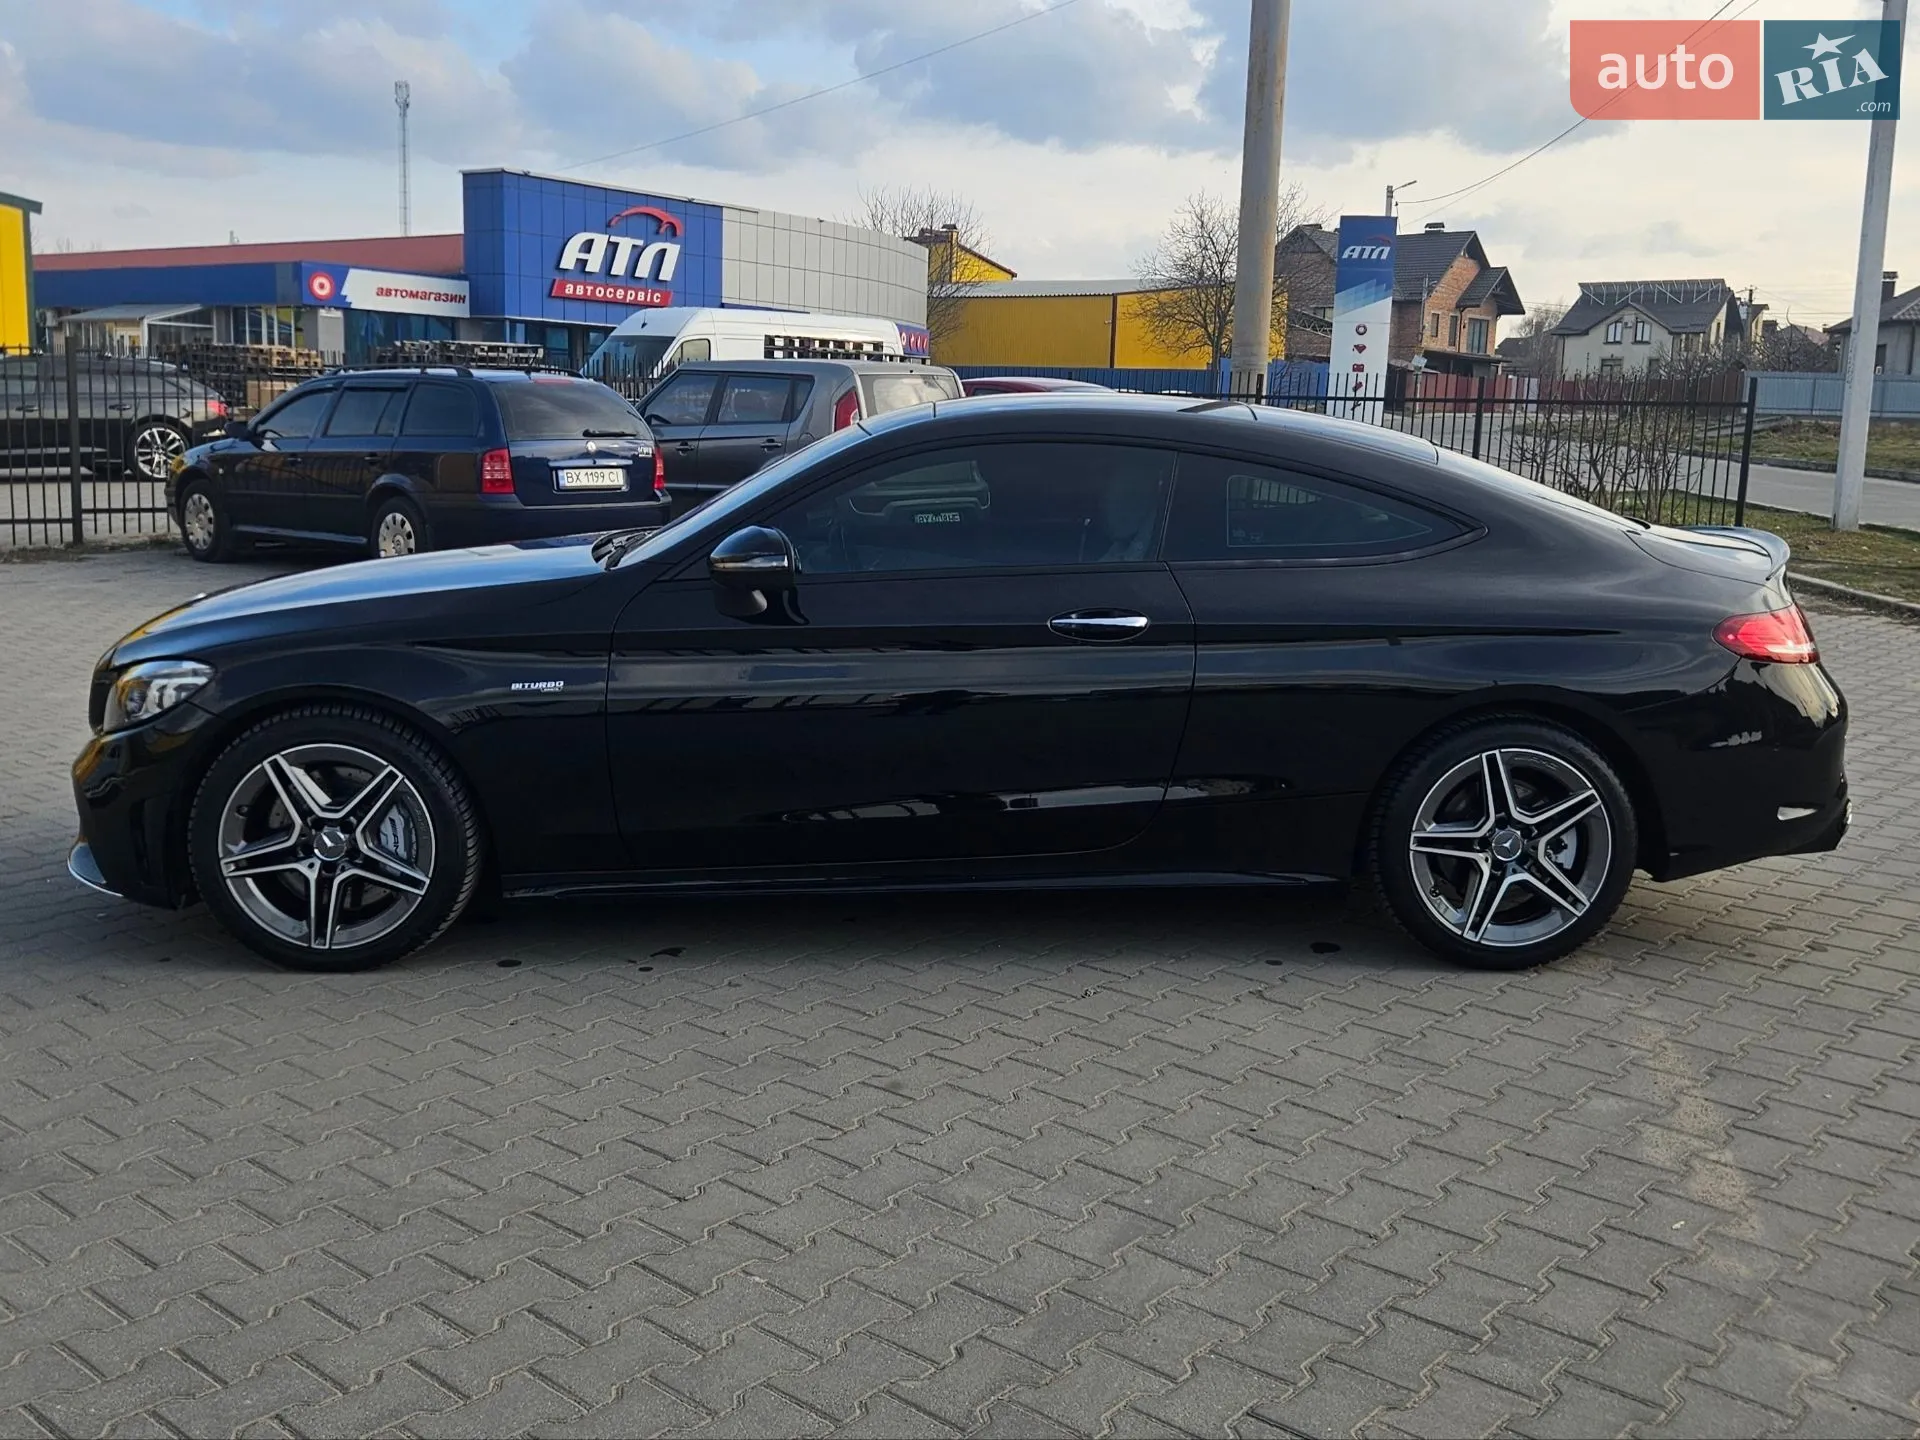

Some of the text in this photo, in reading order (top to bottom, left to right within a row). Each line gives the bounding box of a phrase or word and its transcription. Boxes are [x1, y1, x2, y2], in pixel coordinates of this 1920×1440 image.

[559, 231, 681, 282] АТЛ
[375, 286, 467, 305] автомагазин
[565, 283, 662, 303] автосервіс
[565, 471, 581, 484] BX
[584, 471, 605, 484] 1199
[511, 680, 565, 691] BITURBO
